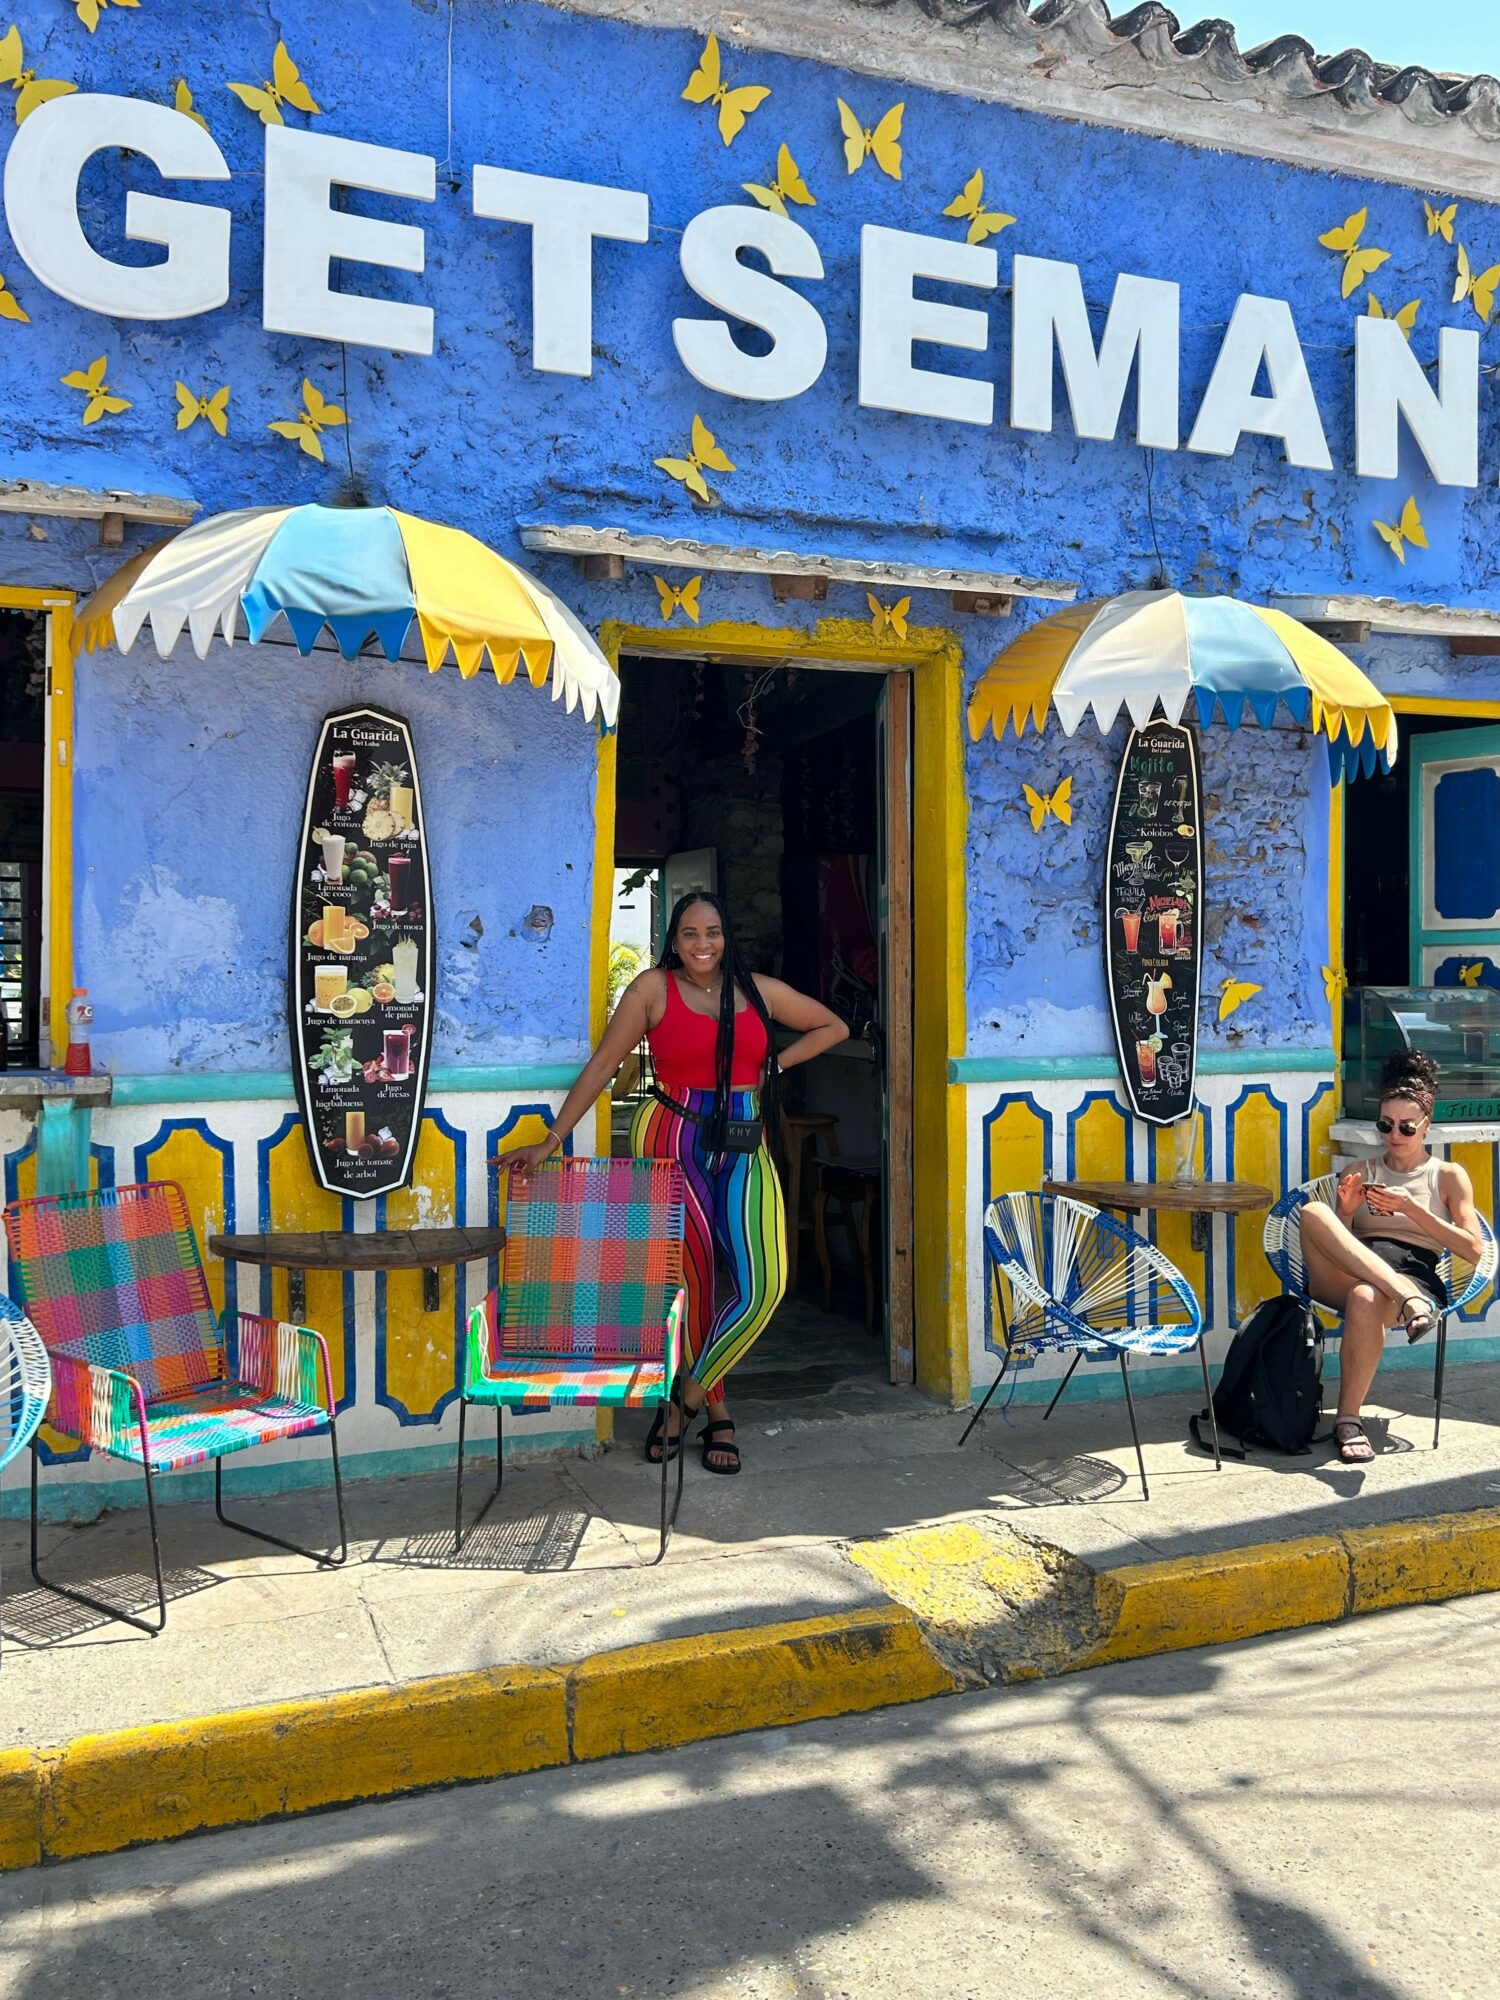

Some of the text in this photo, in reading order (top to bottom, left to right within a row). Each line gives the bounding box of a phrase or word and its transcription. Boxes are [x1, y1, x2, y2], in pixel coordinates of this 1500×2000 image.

[4, 93, 1479, 488] GETSEMAN
[333, 727, 399, 742] La Guarida
[1138, 738, 1185, 749] La Guarida
[1130, 755, 1175, 774] Mojito
[332, 812, 351, 821] Jugo
[368, 840, 387, 849] Jugo
[388, 840, 398, 848] de
[317, 884, 357, 892] Limonada
[1115, 886, 1146, 898] TEQUILA
[372, 921, 391, 930] Jugo
[305, 952, 367, 962] Jugo de naranja
[381, 1004, 419, 1012] Limonada
[305, 1017, 325, 1026] Jugo
[326, 1017, 336, 1025] de
[320, 1084, 360, 1093] Limonada
[383, 1083, 403, 1092] Jugo
[377, 1090, 387, 1098] de
[334, 1159, 354, 1168] Jugo
[355, 1158, 365, 1166] de
[343, 1170, 377, 1179] de arbol
